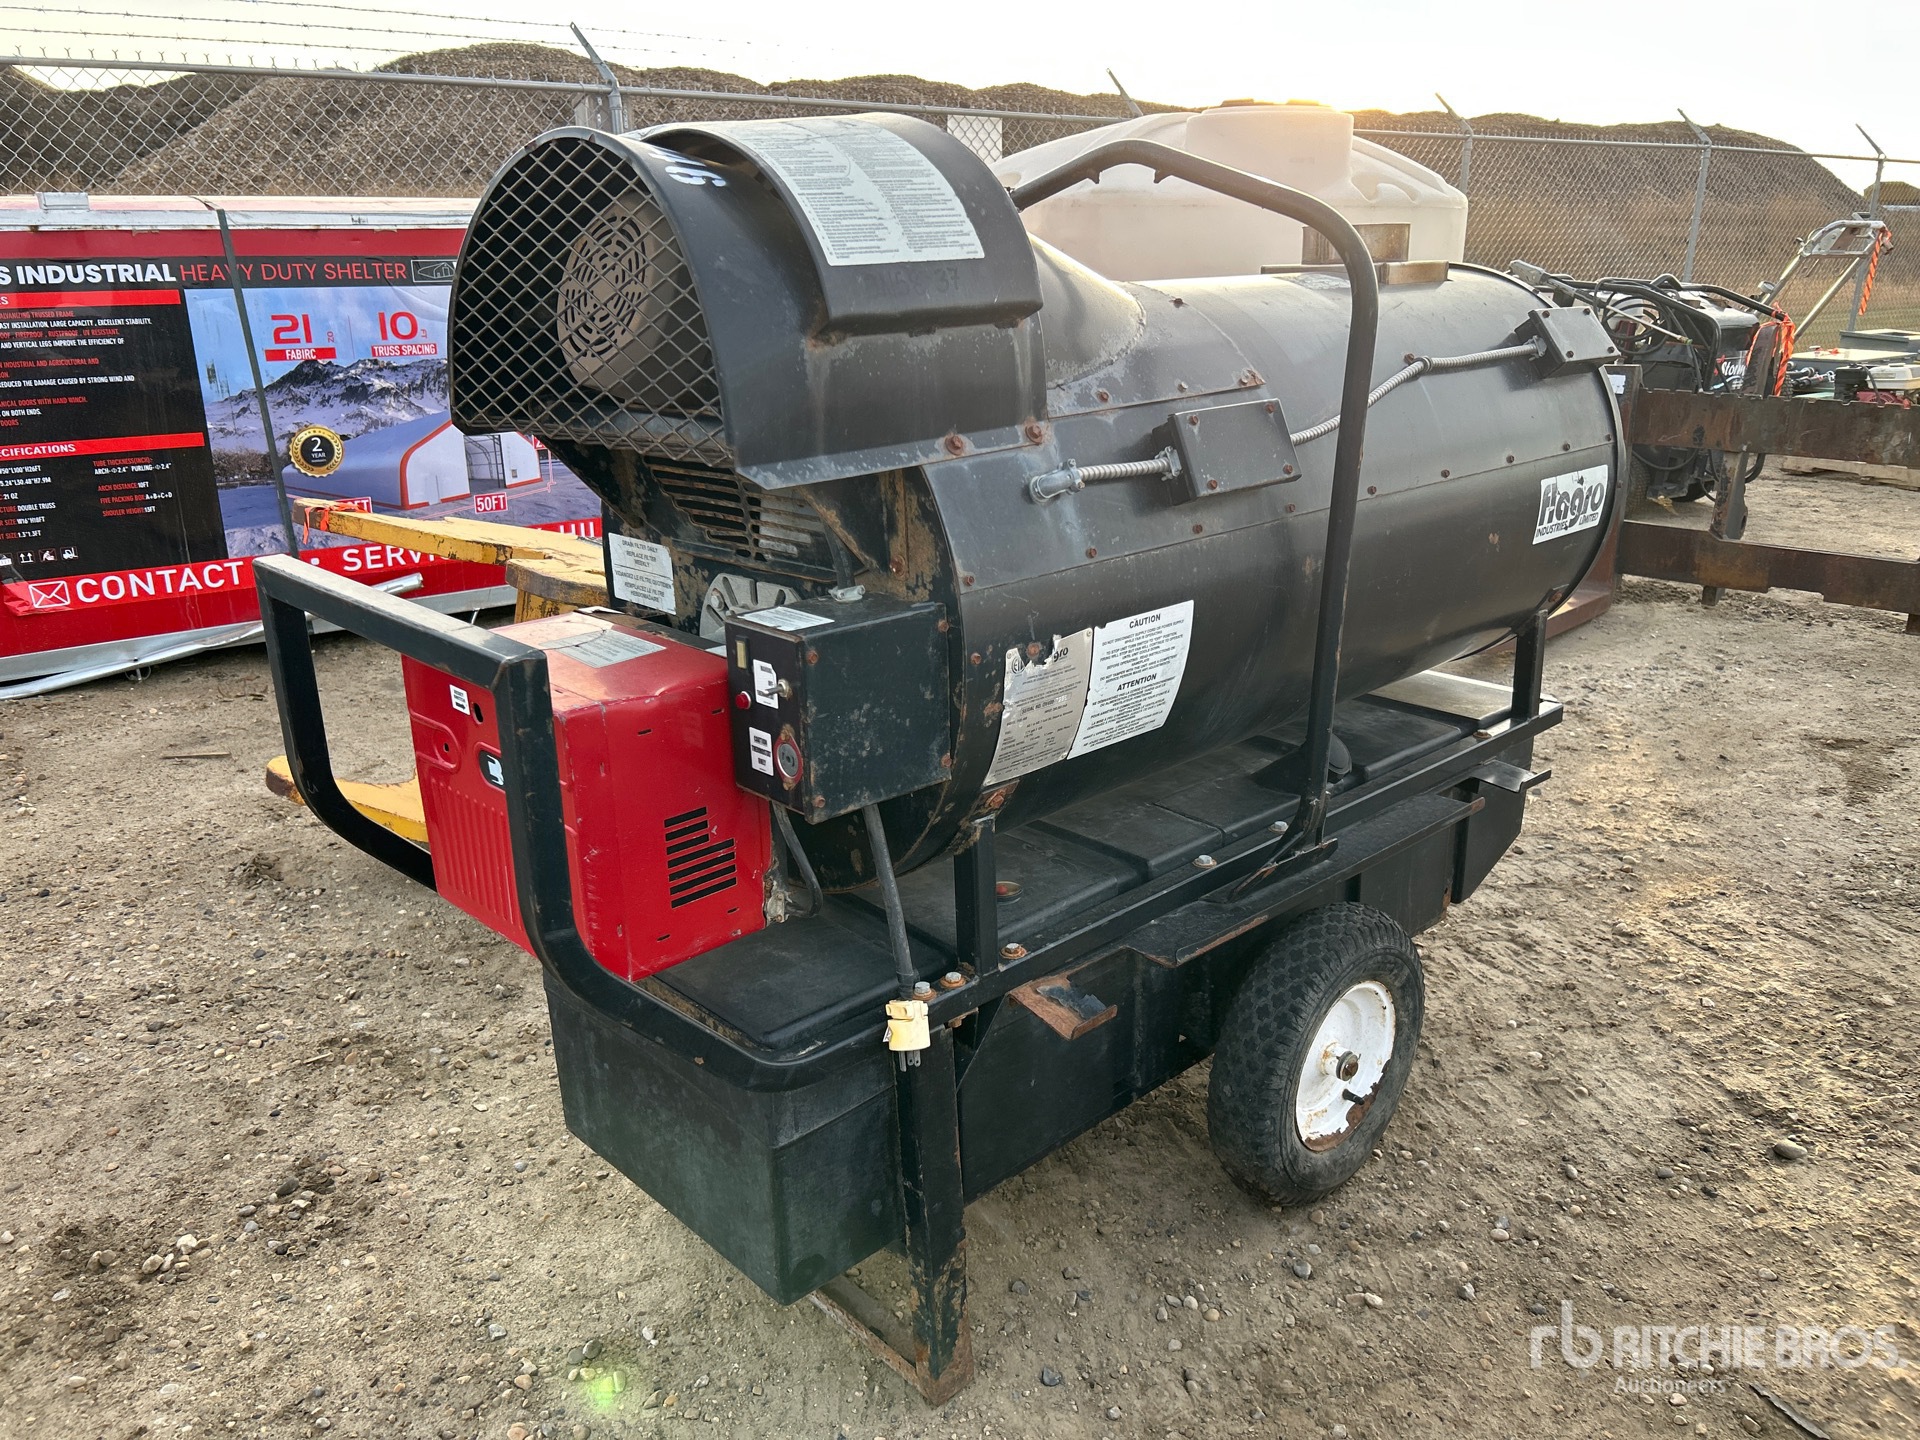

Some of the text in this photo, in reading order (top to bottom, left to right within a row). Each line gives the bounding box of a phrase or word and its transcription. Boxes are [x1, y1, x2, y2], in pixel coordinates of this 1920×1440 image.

[16, 263, 177, 285] INDUSTRIAL
[261, 263, 317, 281] DUTY
[324, 262, 407, 280] SHELTER
[50, 320, 67, 328] LARGE
[97, 318, 125, 326] EXCELLENT
[271, 314, 313, 344] 21
[378, 311, 418, 341] 10
[327, 331, 335, 343] OZ
[420, 329, 428, 338] FT
[13, 341, 38, 349] VERTICAL
[53, 339, 77, 347] IMPROVE
[88, 338, 117, 346] EFFICIENCY
[373, 344, 437, 356] TRUSS SPACING
[285, 349, 317, 360] FABIRC
[4, 360, 36, 368] INDUSTRIAL
[23, 379, 33, 387] THE
[87, 376, 109, 384] STRONG
[11, 409, 26, 417] BOTH
[0, 443, 77, 458] CIFICATIONS
[311, 437, 323, 452] 2
[39, 502, 56, 510] TRUSS
[476, 493, 506, 512] 50FT
[1536, 520, 1569, 538] INDUSTRIES
[76, 545, 449, 604] CONTACT SERV
[1129, 613, 1161, 629] CAUTION
[1116, 673, 1158, 692] ATTENTION
